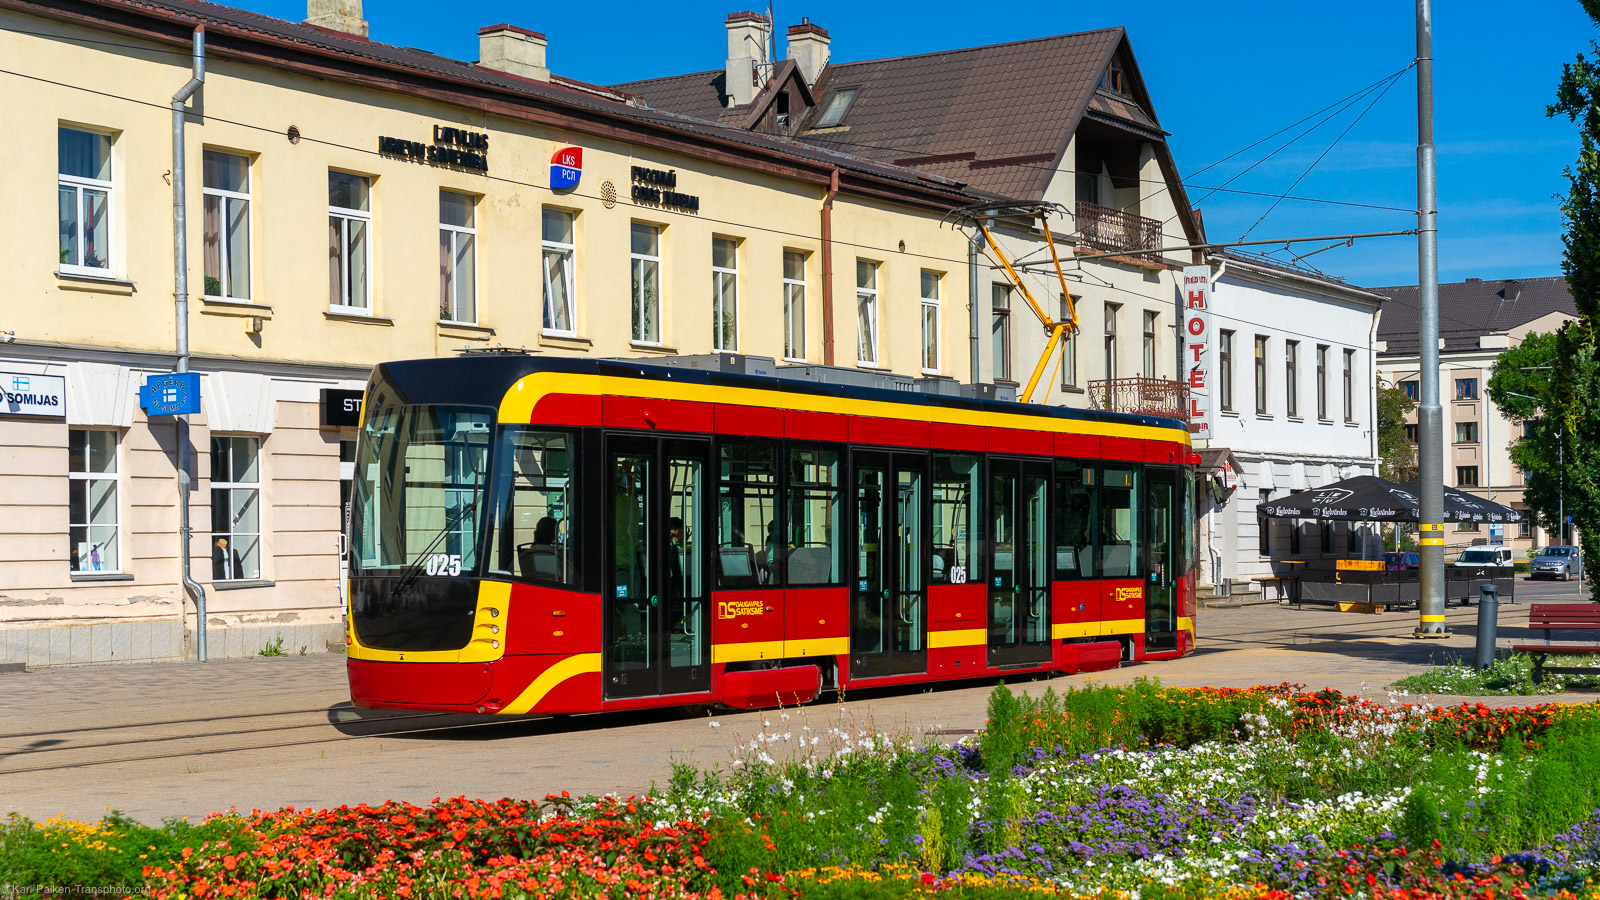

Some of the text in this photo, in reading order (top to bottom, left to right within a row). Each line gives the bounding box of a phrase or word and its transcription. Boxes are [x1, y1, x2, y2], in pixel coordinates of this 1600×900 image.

[562, 153, 576, 166] LKS
[562, 168, 576, 181] РСЛ
[1188, 290, 1205, 417] HOTEL
[7, 392, 59, 407] SOMIJAS
[426, 553, 462, 577] 025
[951, 565, 966, 584] 025
[718, 600, 764, 620] DS DAUGAVPILS
[735, 607, 764, 616] SATIKSME
